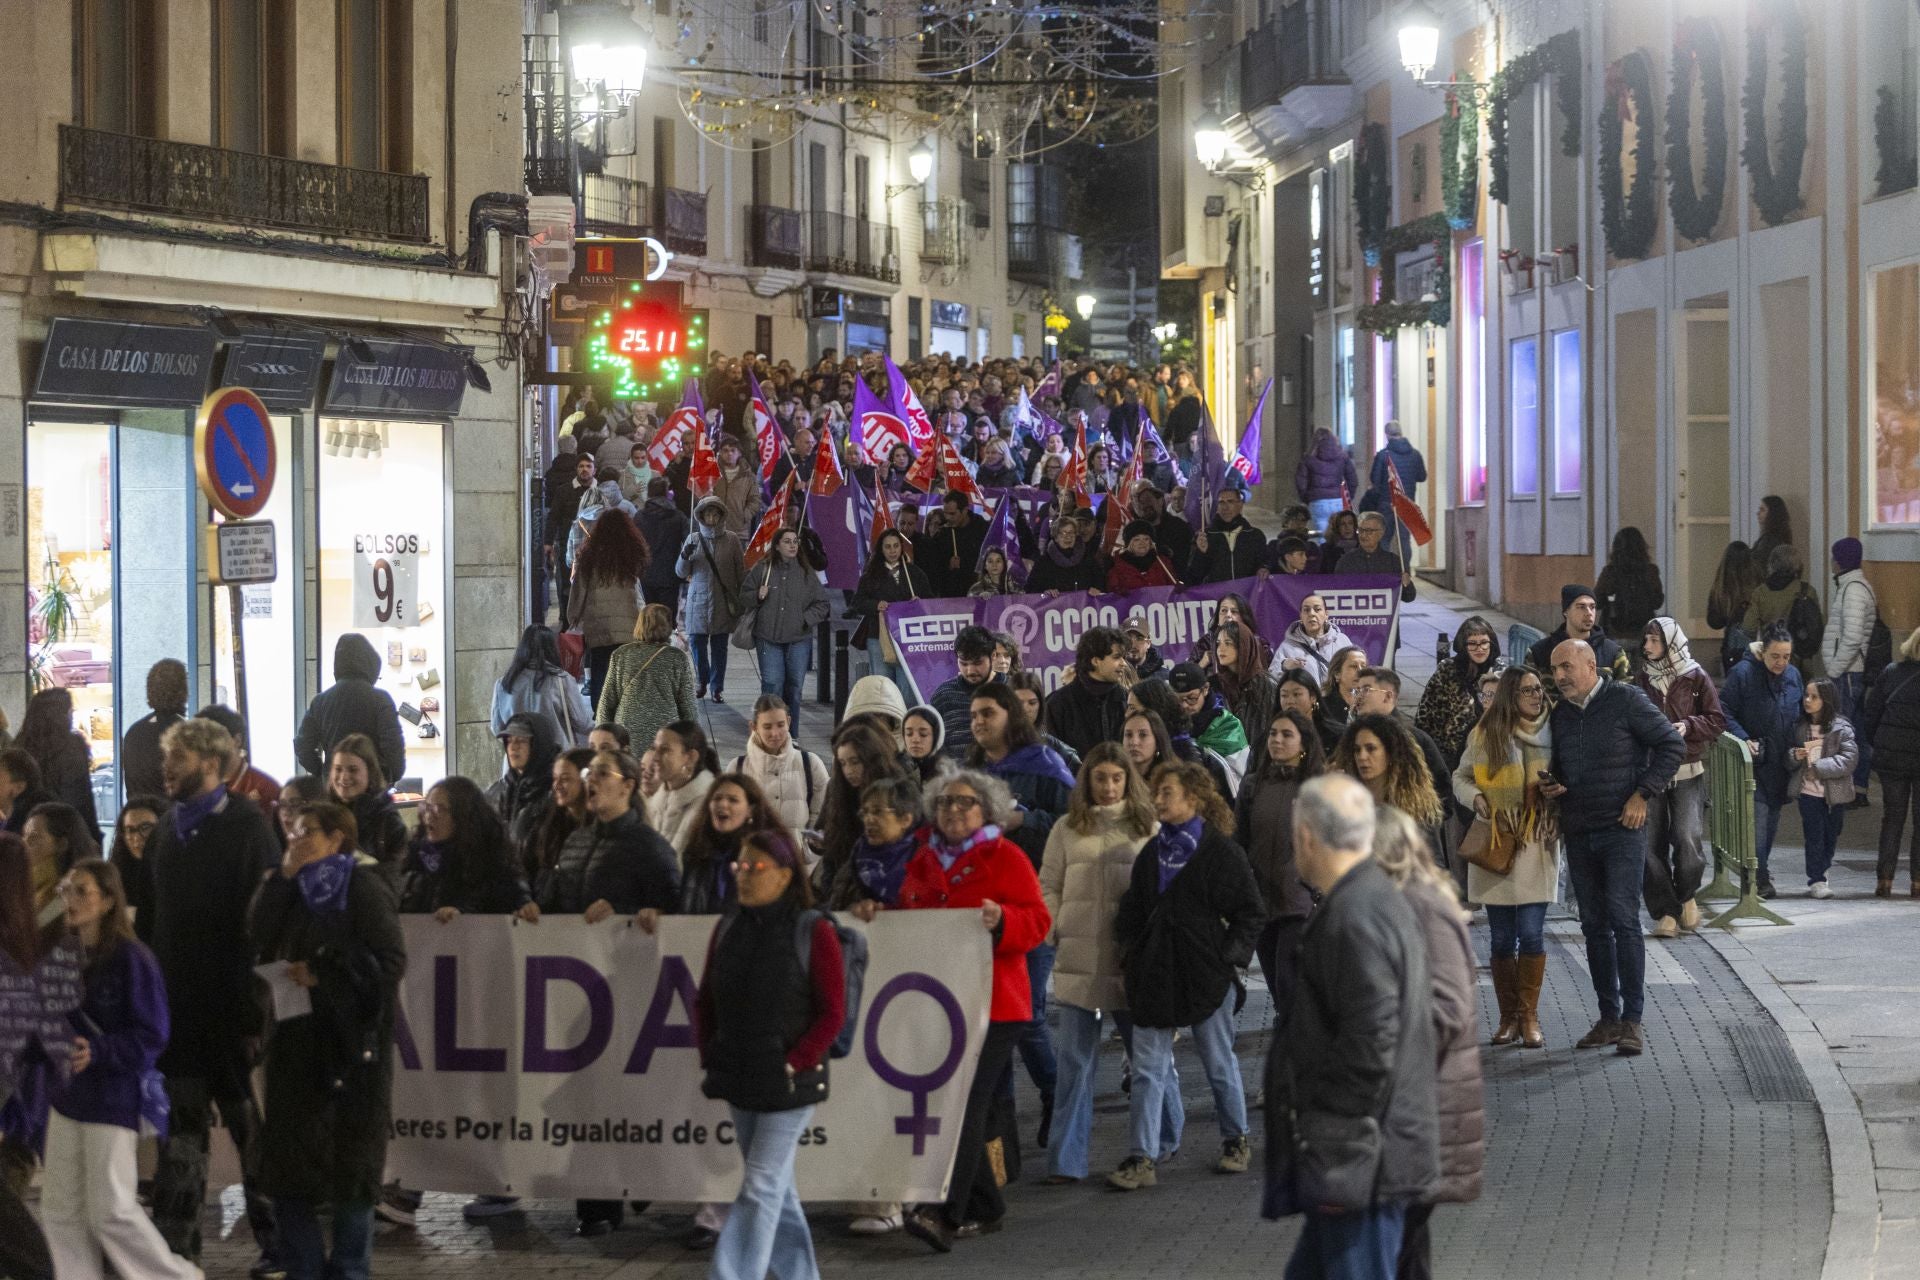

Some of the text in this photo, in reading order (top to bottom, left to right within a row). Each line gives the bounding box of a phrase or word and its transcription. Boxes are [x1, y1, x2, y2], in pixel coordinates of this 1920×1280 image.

[621, 329, 677, 352] 25.11
[59, 345, 200, 377] CASA DE LOS BOLSOS
[344, 363, 459, 390] CASA DE LOS BOLSOS
[863, 417, 902, 461] UG
[355, 534, 418, 554] BOLSOS
[373, 558, 394, 622] 9
[396, 599, 403, 619] €
[1129, 600, 1217, 646] ONT
[1330, 615, 1387, 626] tremadura
[908, 642, 955, 653] extremad
[390, 1118, 447, 1140] eres
[455, 1115, 502, 1140] Por
[510, 1116, 533, 1141] la
[543, 1117, 663, 1147] Igualdad
[672, 1118, 708, 1145] de
